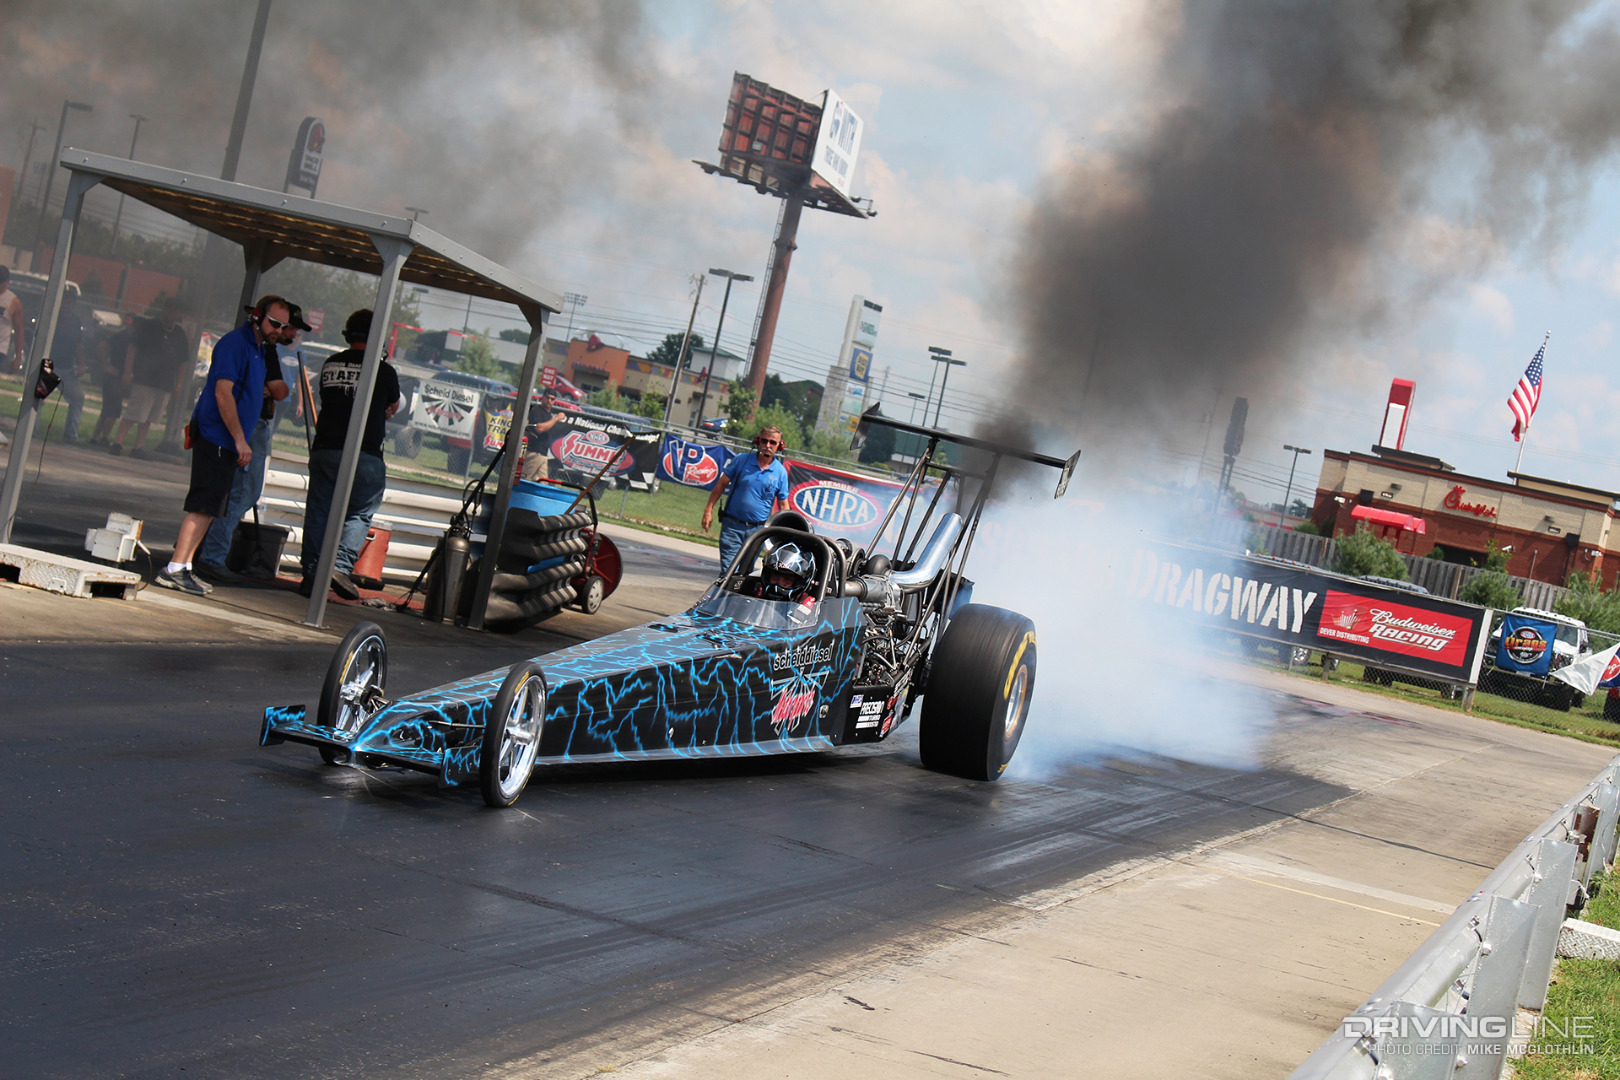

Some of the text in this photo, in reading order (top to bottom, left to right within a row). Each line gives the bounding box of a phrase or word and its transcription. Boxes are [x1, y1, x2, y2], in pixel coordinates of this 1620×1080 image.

[424, 384, 474, 404] Scheid Diesel
[567, 416, 574, 424] a
[575, 416, 607, 431] National
[563, 434, 623, 465] SUMMI
[669, 440, 706, 481] VP
[686, 466, 718, 479] Racing
[818, 481, 859, 494] MEMBER
[801, 489, 869, 524] NHRA
[1126, 549, 1317, 634] DRAGWAY
[1320, 627, 1370, 644] DEVER DISTRIBUTING
[1369, 608, 1457, 638] Budweiser
[773, 638, 835, 671] scheiddiesel
